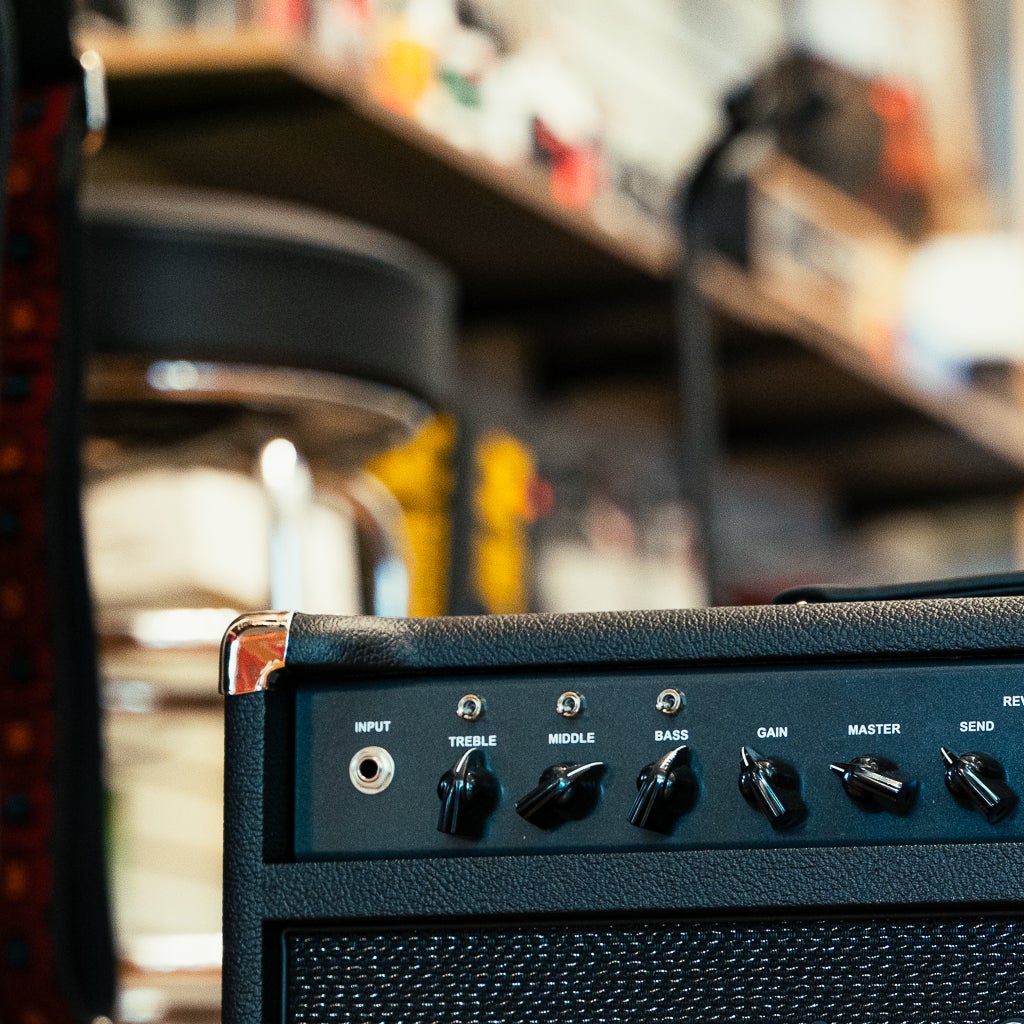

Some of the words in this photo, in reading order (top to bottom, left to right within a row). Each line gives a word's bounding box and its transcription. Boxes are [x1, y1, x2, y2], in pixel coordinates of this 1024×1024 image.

[353, 719, 392, 734] INPUT
[756, 726, 789, 739] GAIN
[847, 722, 901, 737] MASTER
[958, 720, 995, 733] SEND
[447, 734, 498, 748] TREBLE
[547, 731, 596, 745] MIDDLE
[653, 728, 689, 742] BASS
